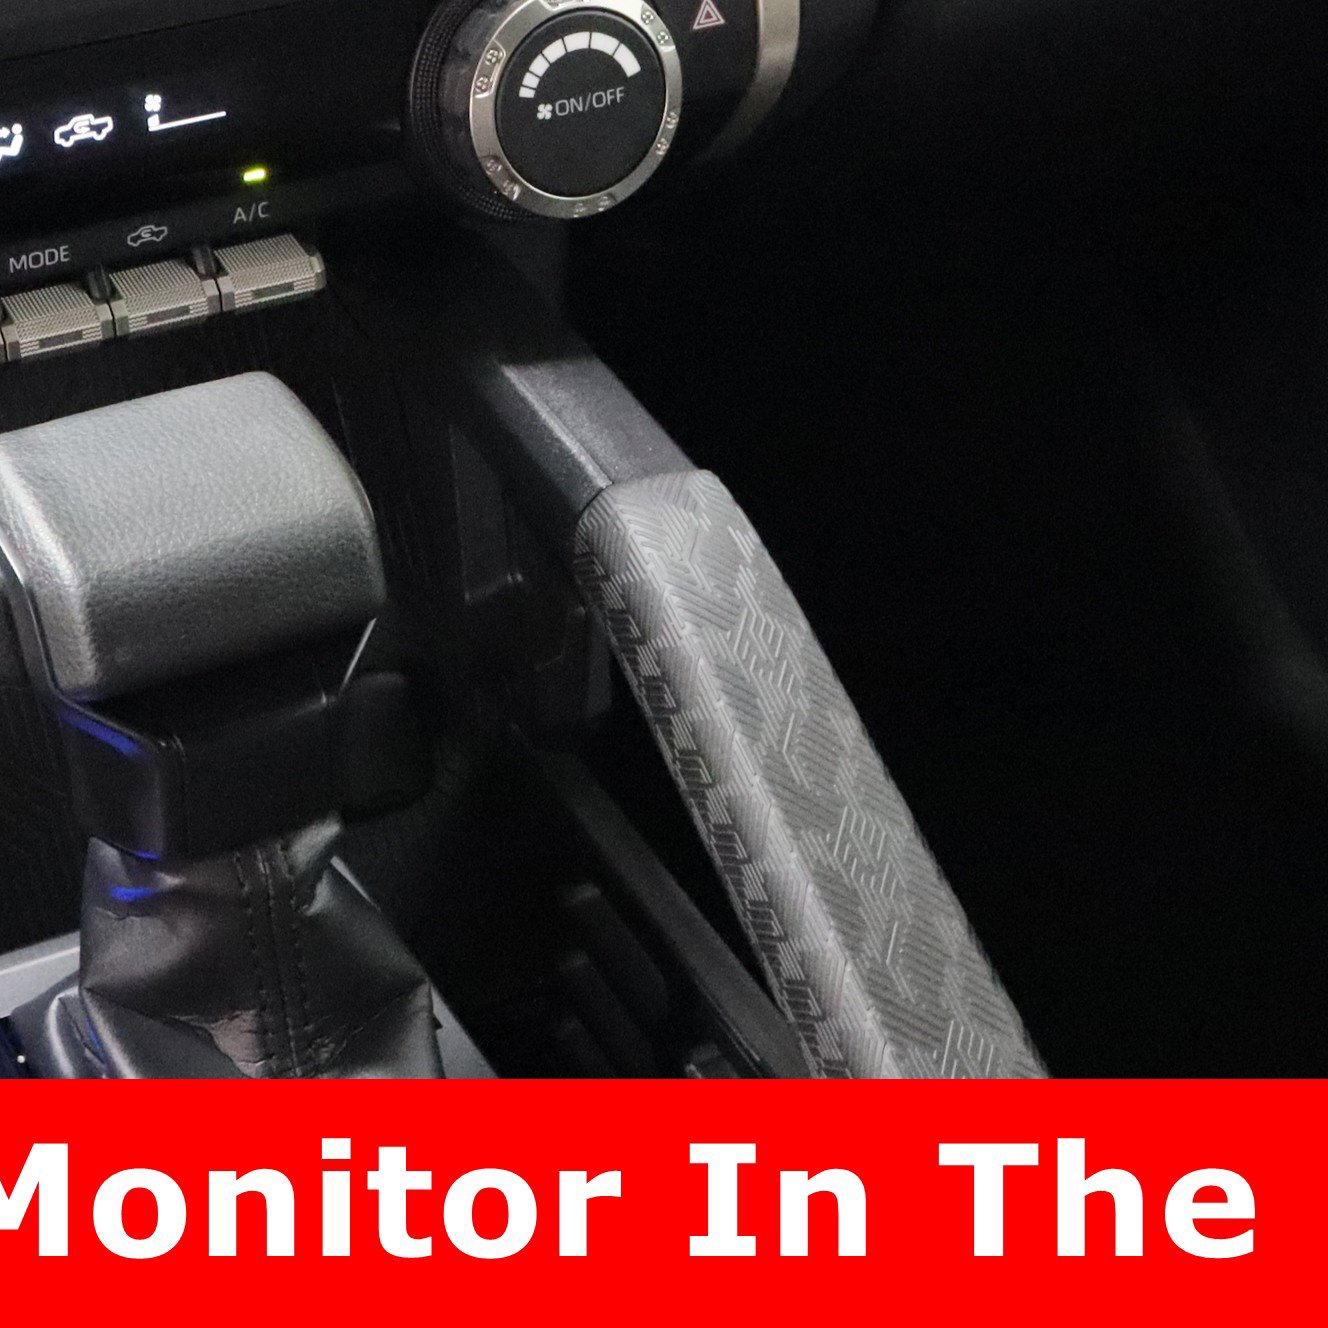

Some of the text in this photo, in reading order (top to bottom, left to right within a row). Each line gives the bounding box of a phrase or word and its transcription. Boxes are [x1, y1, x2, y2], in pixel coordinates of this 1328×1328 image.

[554, 86, 626, 118] ON/OFF
[232, 200, 271, 225] A/C
[8, 243, 71, 274] MODE
